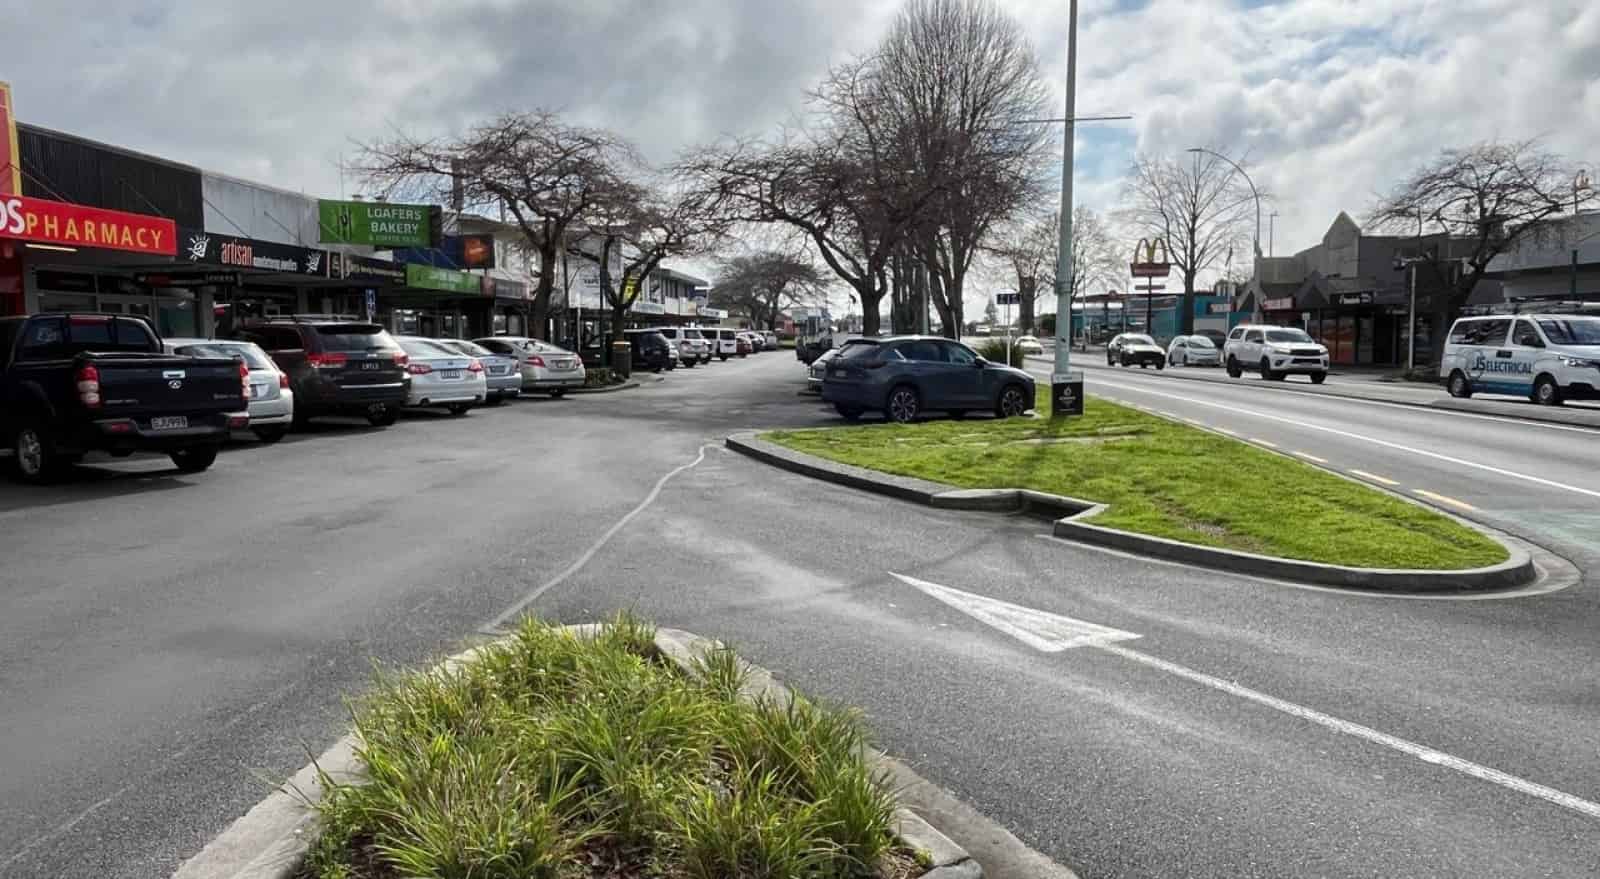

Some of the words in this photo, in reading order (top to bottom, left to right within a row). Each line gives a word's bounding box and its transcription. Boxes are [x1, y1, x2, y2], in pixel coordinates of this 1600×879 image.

[367, 207, 422, 220] LOAFERS
[25, 212, 164, 249] PHARMACY
[371, 222, 418, 234] BAKERY
[221, 239, 252, 266] artisan
